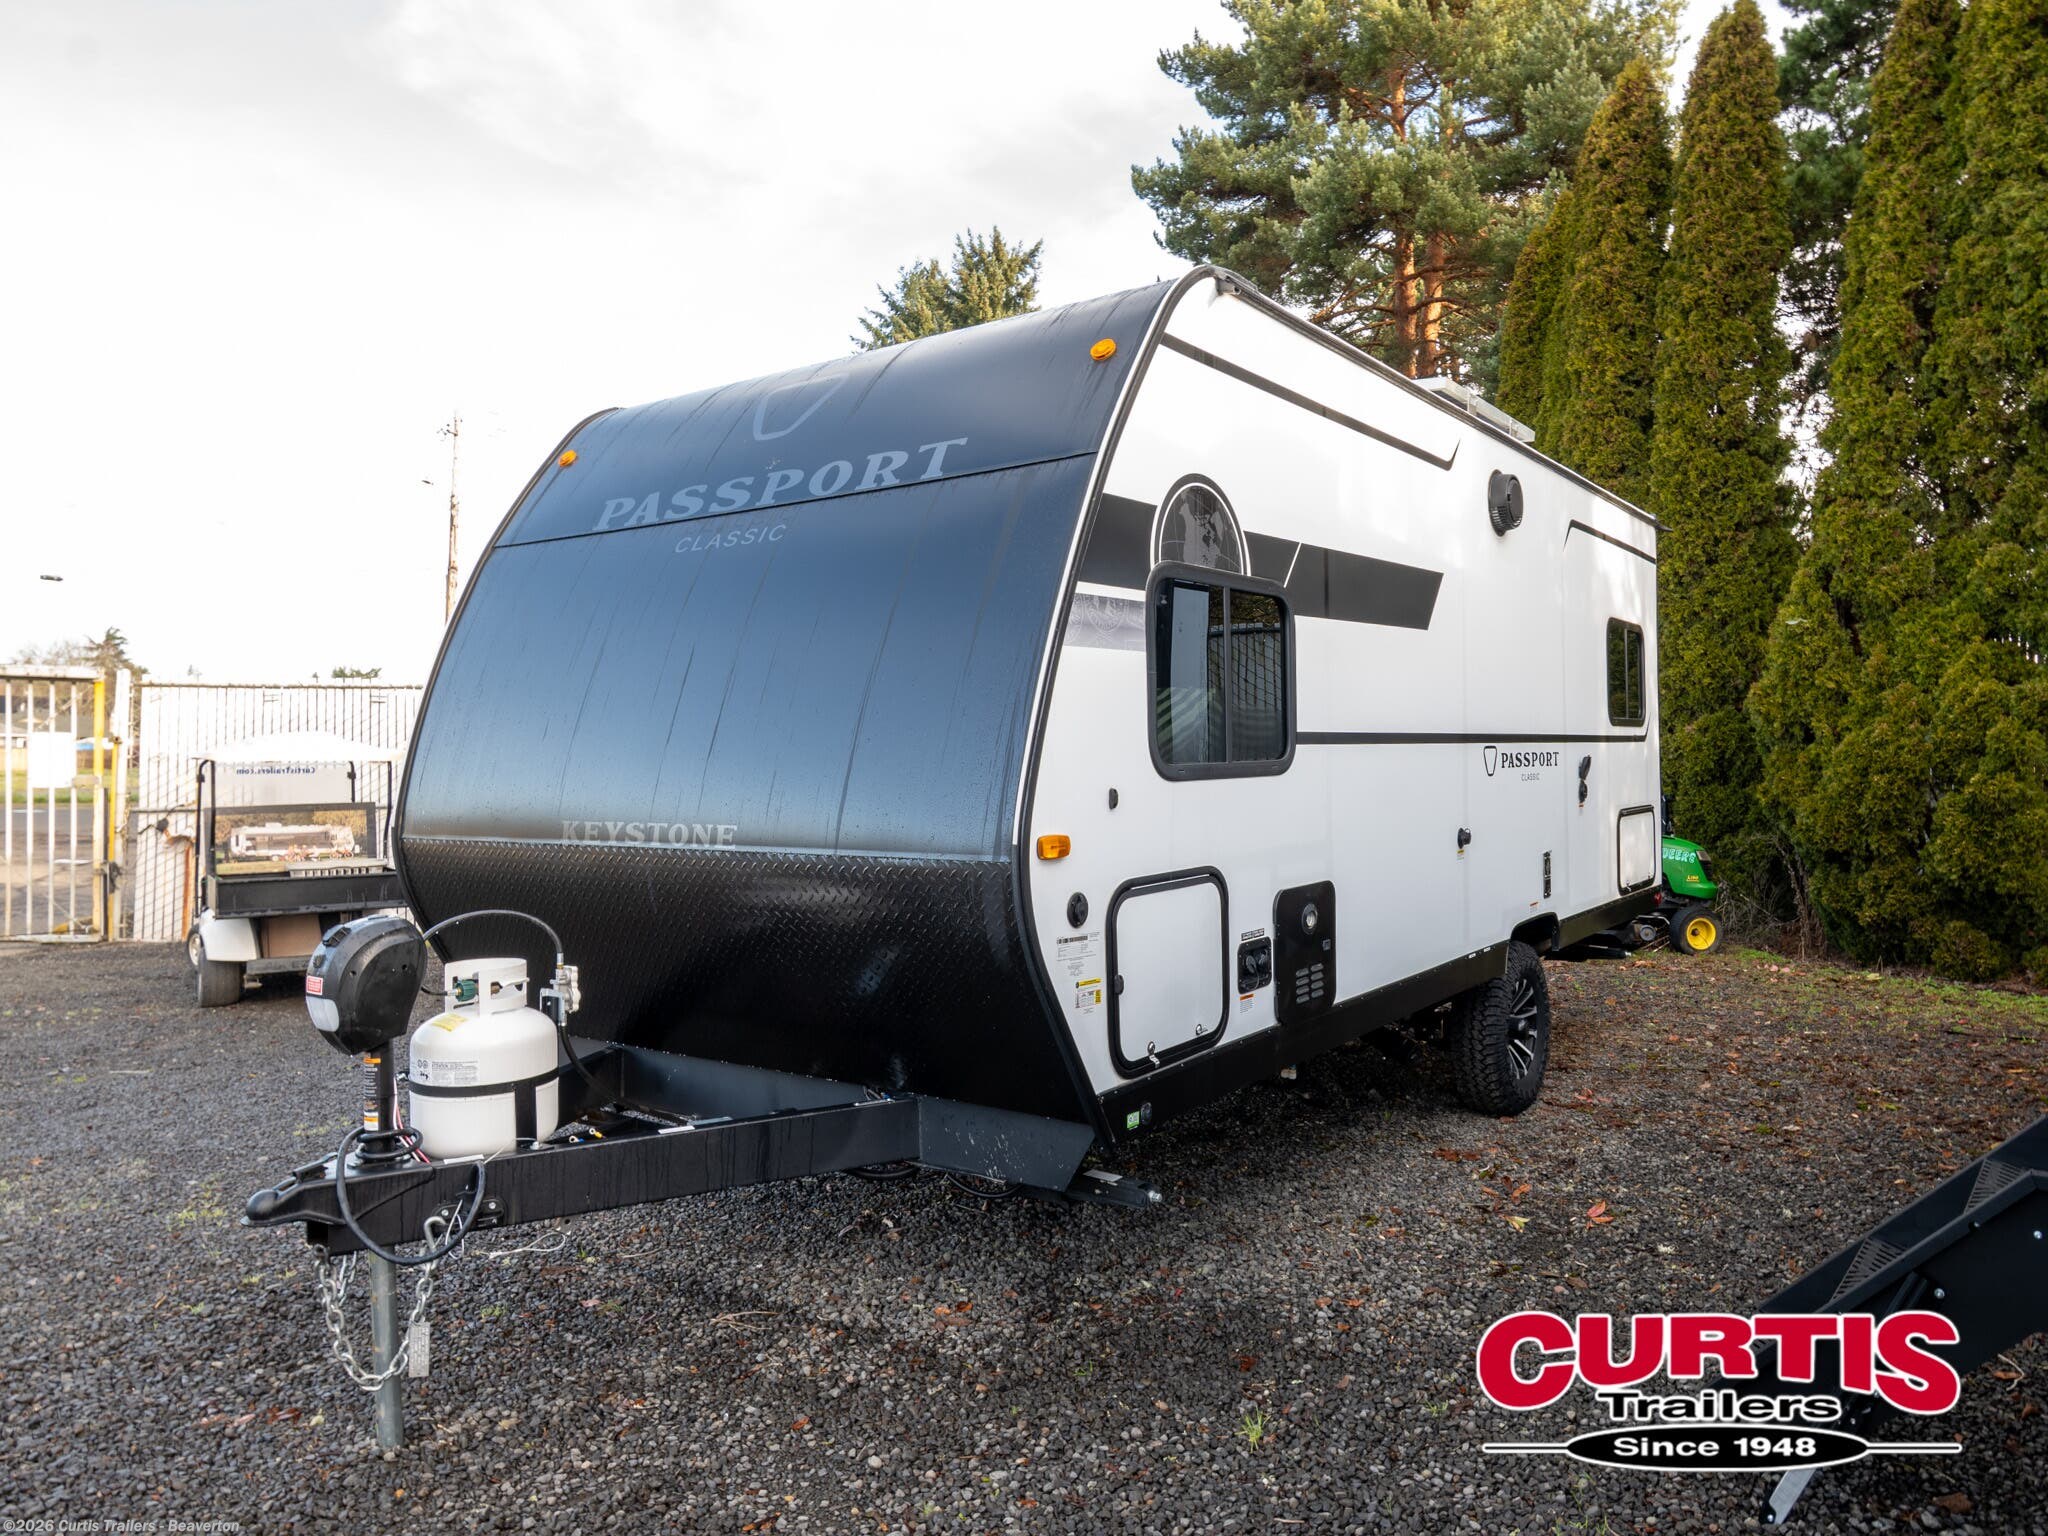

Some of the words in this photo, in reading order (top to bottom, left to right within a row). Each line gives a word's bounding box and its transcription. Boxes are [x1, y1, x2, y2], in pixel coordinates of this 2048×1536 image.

[592, 437, 968, 531] PASSPORT
[675, 524, 786, 553] CLASSIC
[1501, 752, 1559, 768] PASSPORT
[561, 820, 738, 849] KEYSTONE
